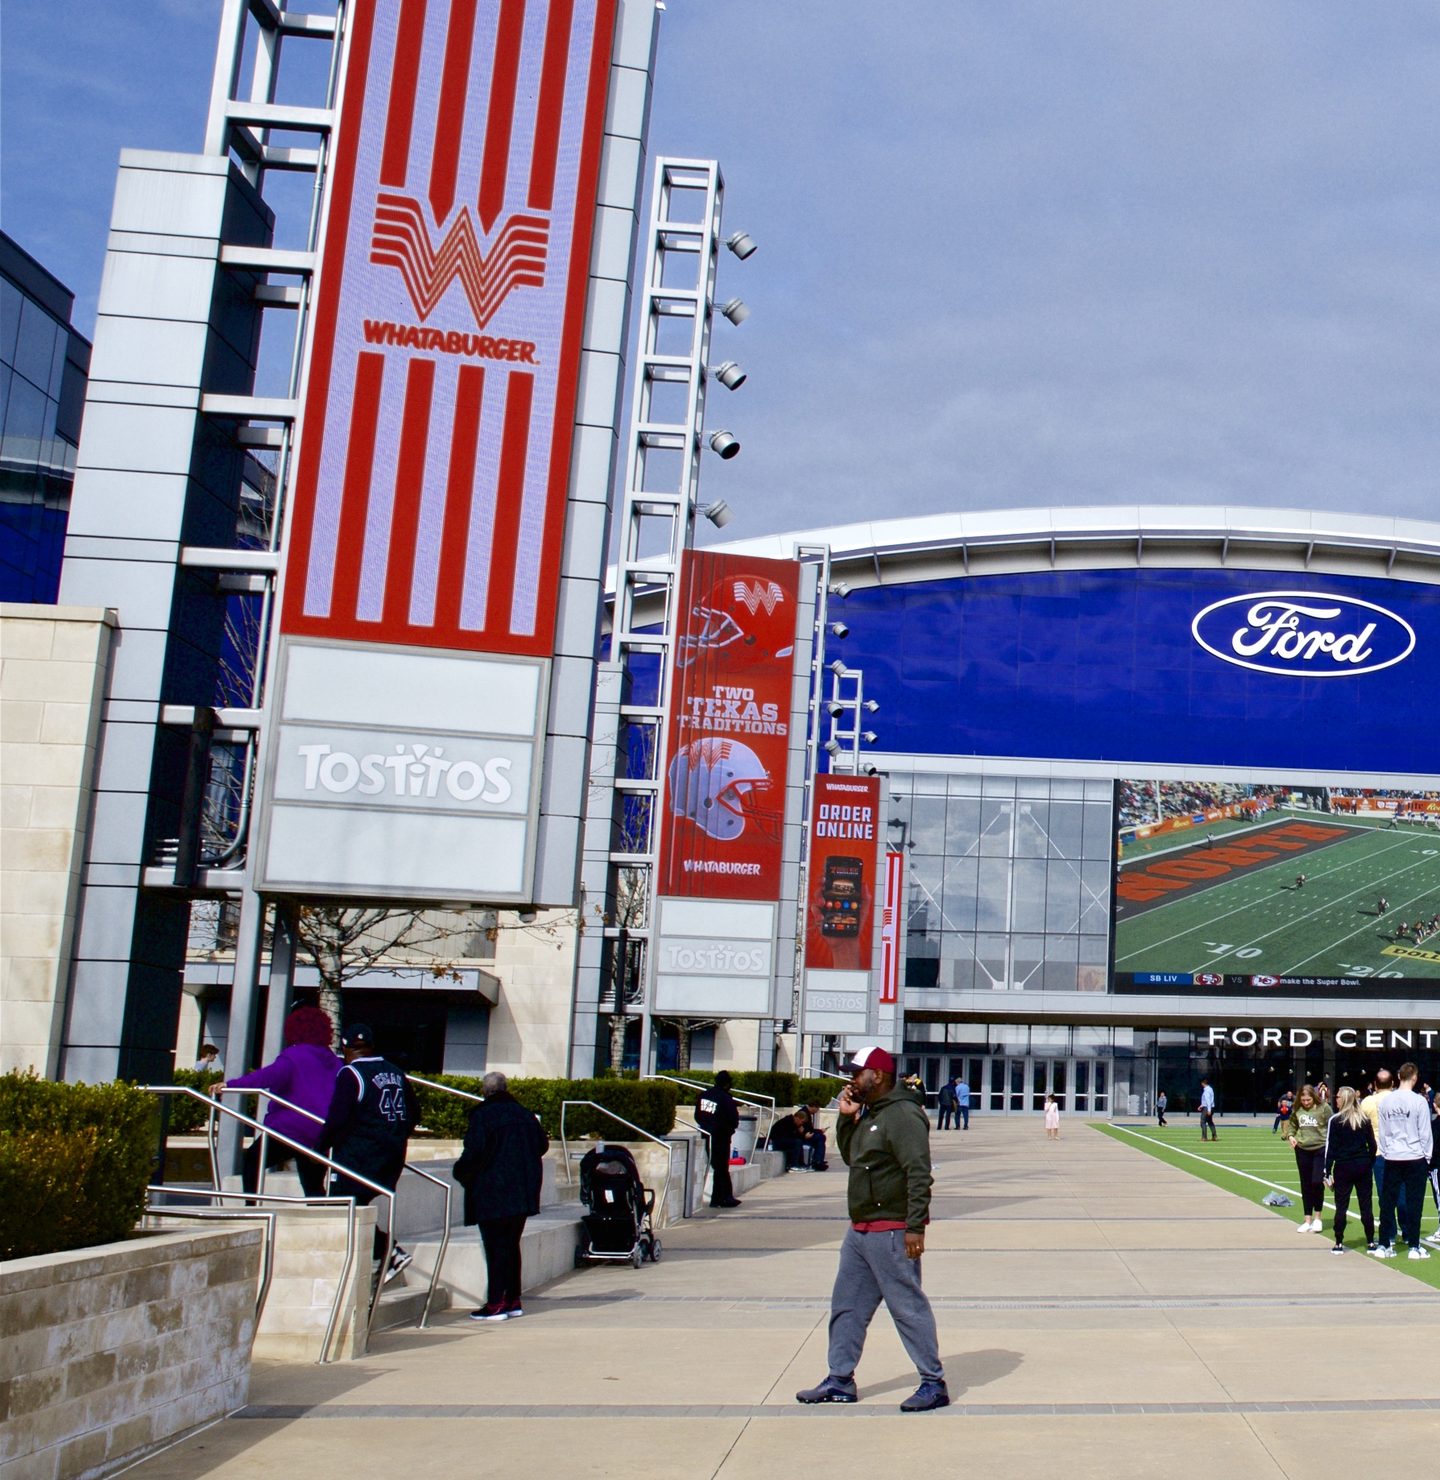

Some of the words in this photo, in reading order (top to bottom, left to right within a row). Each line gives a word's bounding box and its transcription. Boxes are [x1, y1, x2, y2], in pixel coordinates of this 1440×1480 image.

[364, 319, 539, 365] WHATABURGER
[1232, 601, 1377, 663] Ford
[712, 685, 755, 701] TWO
[687, 696, 779, 723] TEXAS
[676, 714, 788, 736] TRADITIONS
[819, 804, 872, 822] ORDER
[816, 821, 874, 840] ONLINE
[683, 859, 761, 876] WHATABURGER
[1117, 823, 1349, 902] NORTH
[1149, 974, 1162, 983] SB
[1163, 974, 1178, 983] LIV
[1279, 978, 1301, 986] make
[1302, 978, 1315, 986] the
[1316, 978, 1339, 987] Super
[1208, 1026, 1313, 1047] FORD
[379, 1088, 406, 1121] 44
